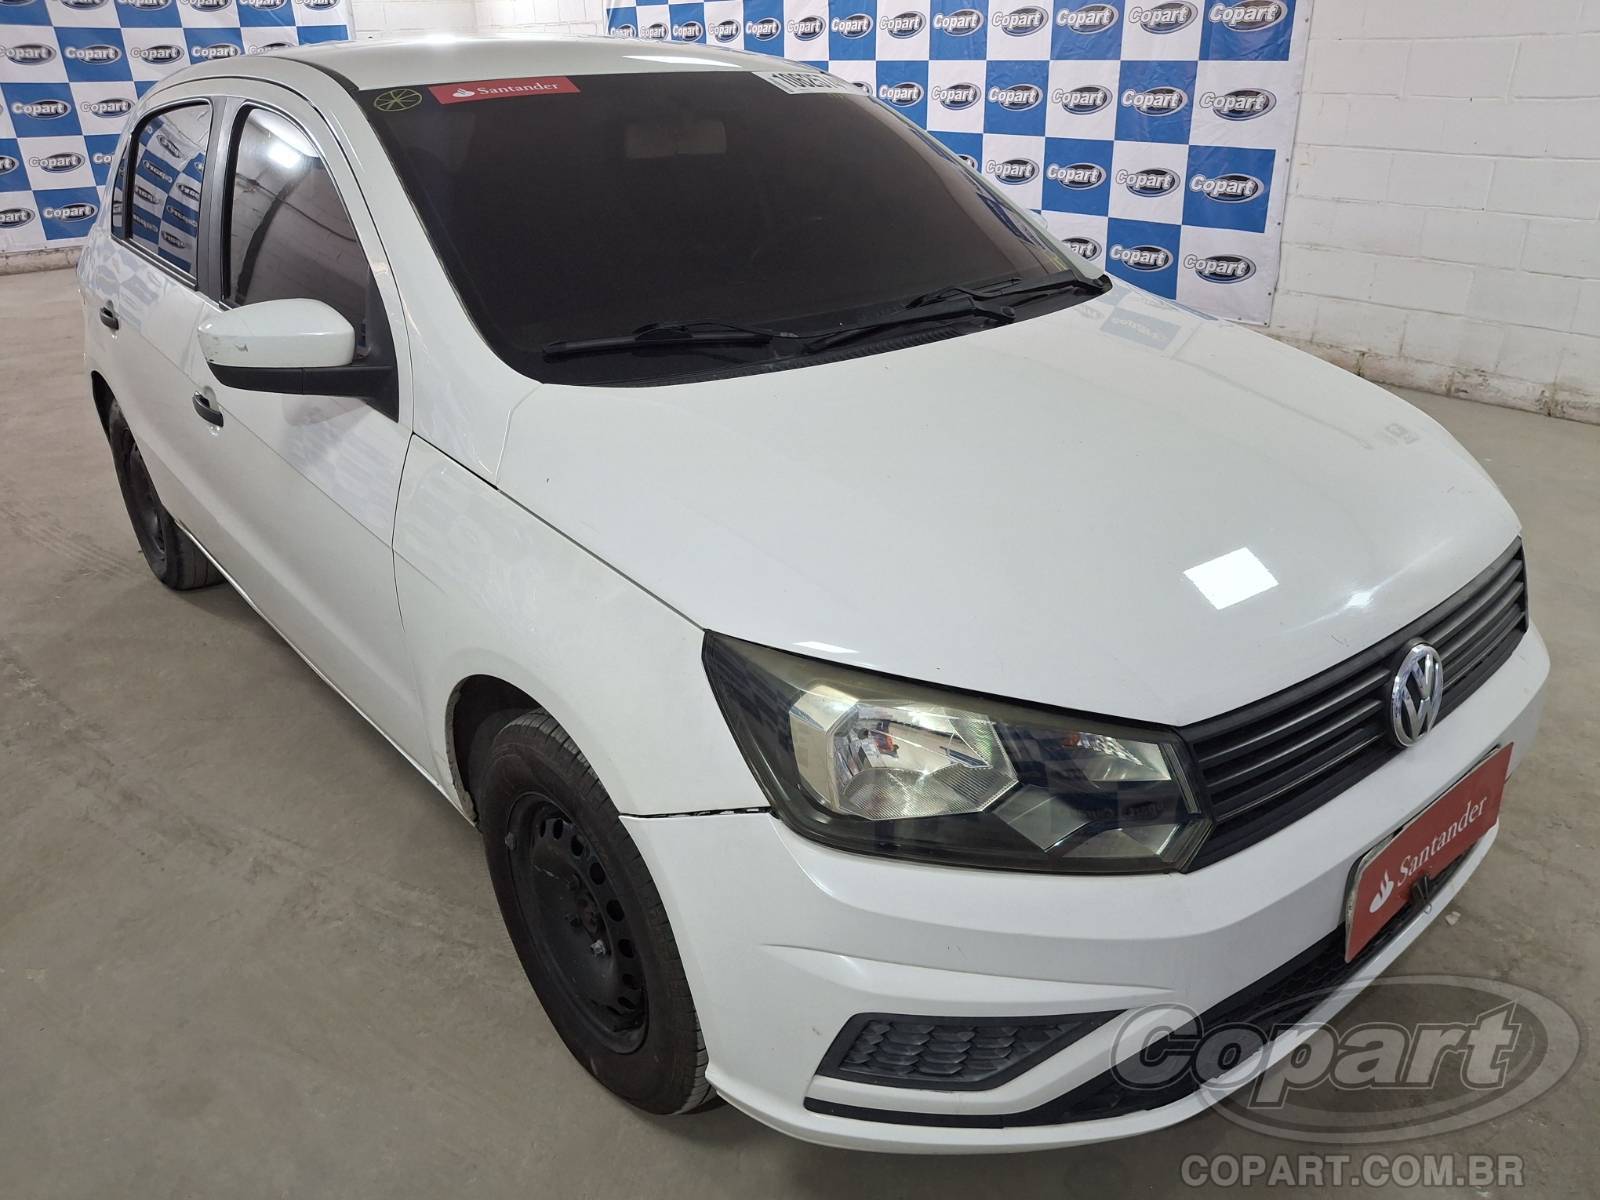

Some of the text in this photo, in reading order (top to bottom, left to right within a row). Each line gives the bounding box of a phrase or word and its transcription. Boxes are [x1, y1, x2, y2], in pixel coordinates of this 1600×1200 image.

[933, 13, 977, 32] Copart
[992, 10, 1041, 29] Copart
[1057, 4, 1111, 25] Copart
[1128, 5, 1193, 25] Copart
[1209, 2, 1278, 24] Copart
[673, 24, 699, 38] Copart
[708, 23, 736, 38] Copart
[745, 22, 777, 37] Copart
[787, 20, 820, 36] Copart
[831, 17, 868, 35] Copart
[880, 14, 920, 33] Copart
[65, 46, 117, 60] Copart
[131, 46, 179, 60] Copart
[192, 46, 235, 59] Copart
[477, 82, 559, 97] Santander
[879, 86, 919, 104] Copart
[932, 85, 974, 104] Copart
[988, 86, 1037, 105] Copart
[1051, 88, 1104, 110] Copart
[12, 102, 65, 117] Copart
[81, 101, 128, 115] Copart
[1121, 89, 1183, 111] Copart
[1199, 92, 1265, 115] Copart
[29, 156, 78, 170] Copart
[986, 160, 1033, 179] Copart
[1047, 164, 1100, 184] Copart
[1116, 170, 1174, 191] Copart
[1190, 175, 1255, 199] Copart
[43, 206, 92, 221] Copart
[1110, 245, 1166, 265] Copart
[1184, 254, 1247, 276] Copart
[1397, 797, 1487, 887] Santander
